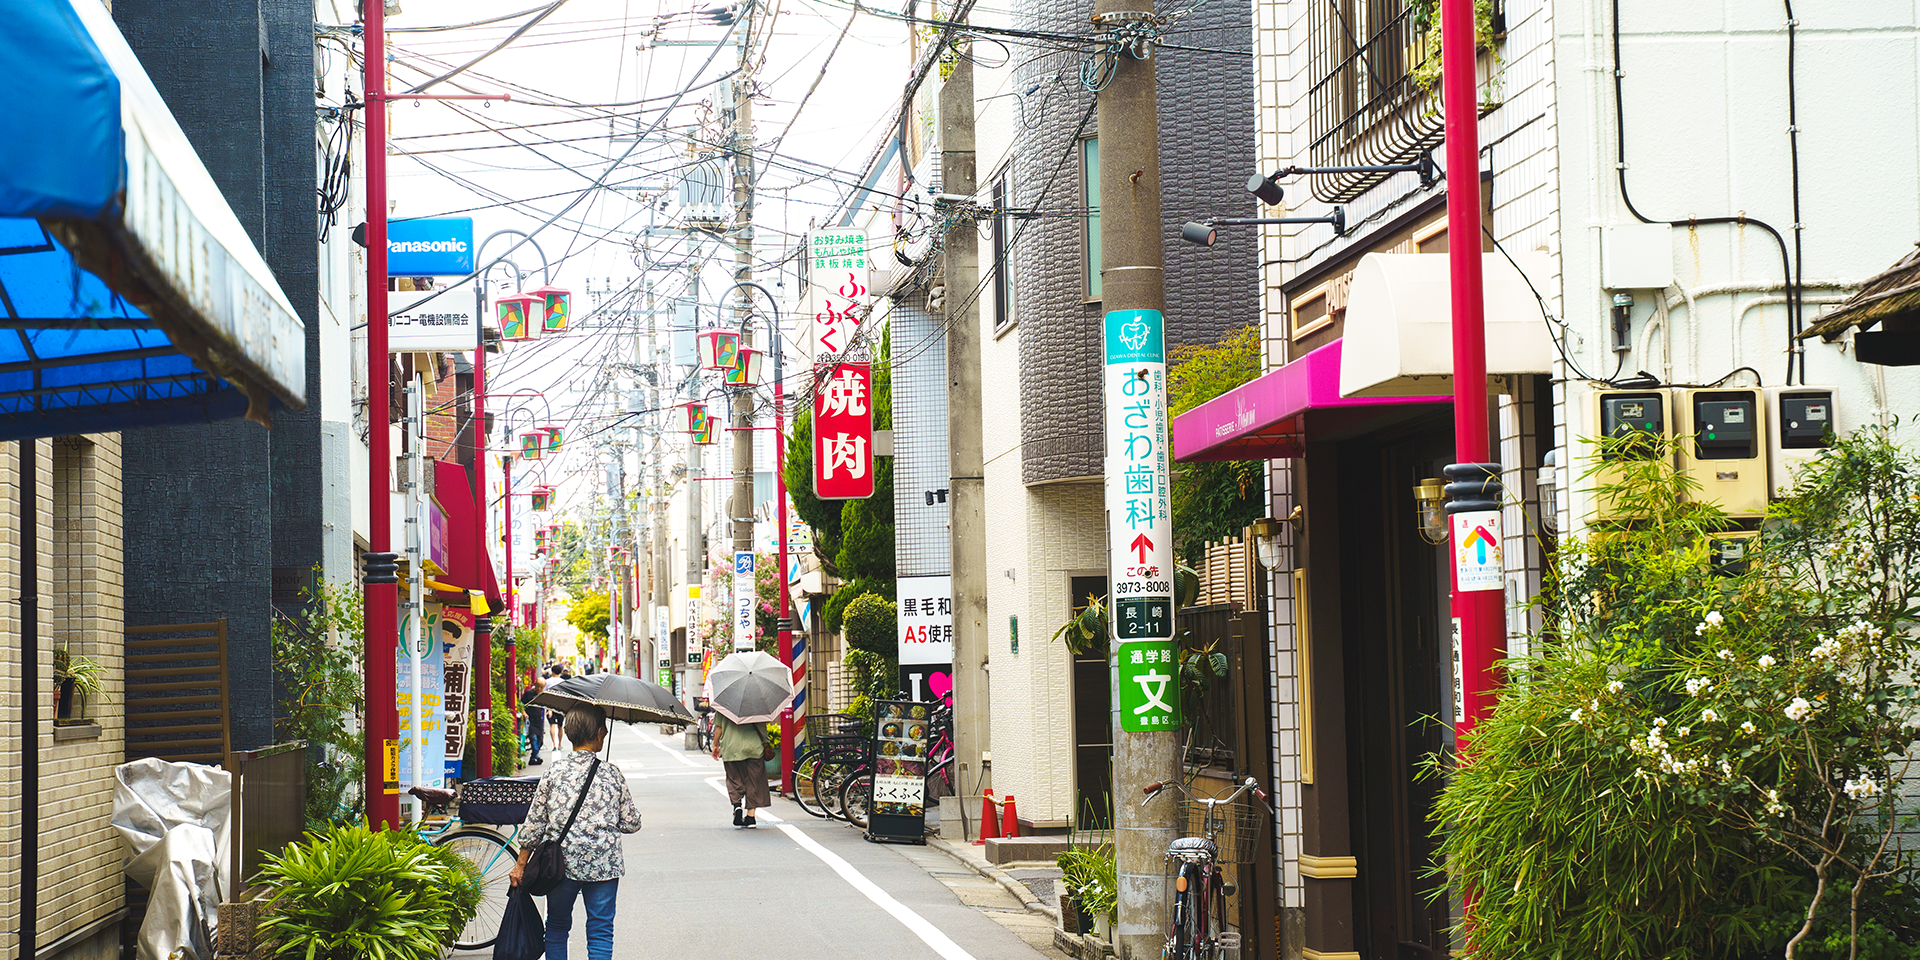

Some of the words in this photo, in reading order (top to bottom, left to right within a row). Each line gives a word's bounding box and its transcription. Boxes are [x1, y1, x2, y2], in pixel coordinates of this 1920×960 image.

[814, 235, 864, 246] お好み焼き
[814, 247, 864, 257] もんじゃ焼き
[815, 258, 865, 268] 鉄板焼き
[818, 369, 867, 480] 焼肉
[1122, 368, 1155, 530] おざわ歯科
[1126, 566, 1160, 577] この先
[1116, 581, 1170, 593] 3973-8008
[1129, 621, 1160, 633] 2-11
[1130, 650, 1171, 664] 通学路
[1133, 668, 1173, 715] 文
[1140, 715, 1170, 725] 豊島区
[876, 786, 922, 801] ふくふく
